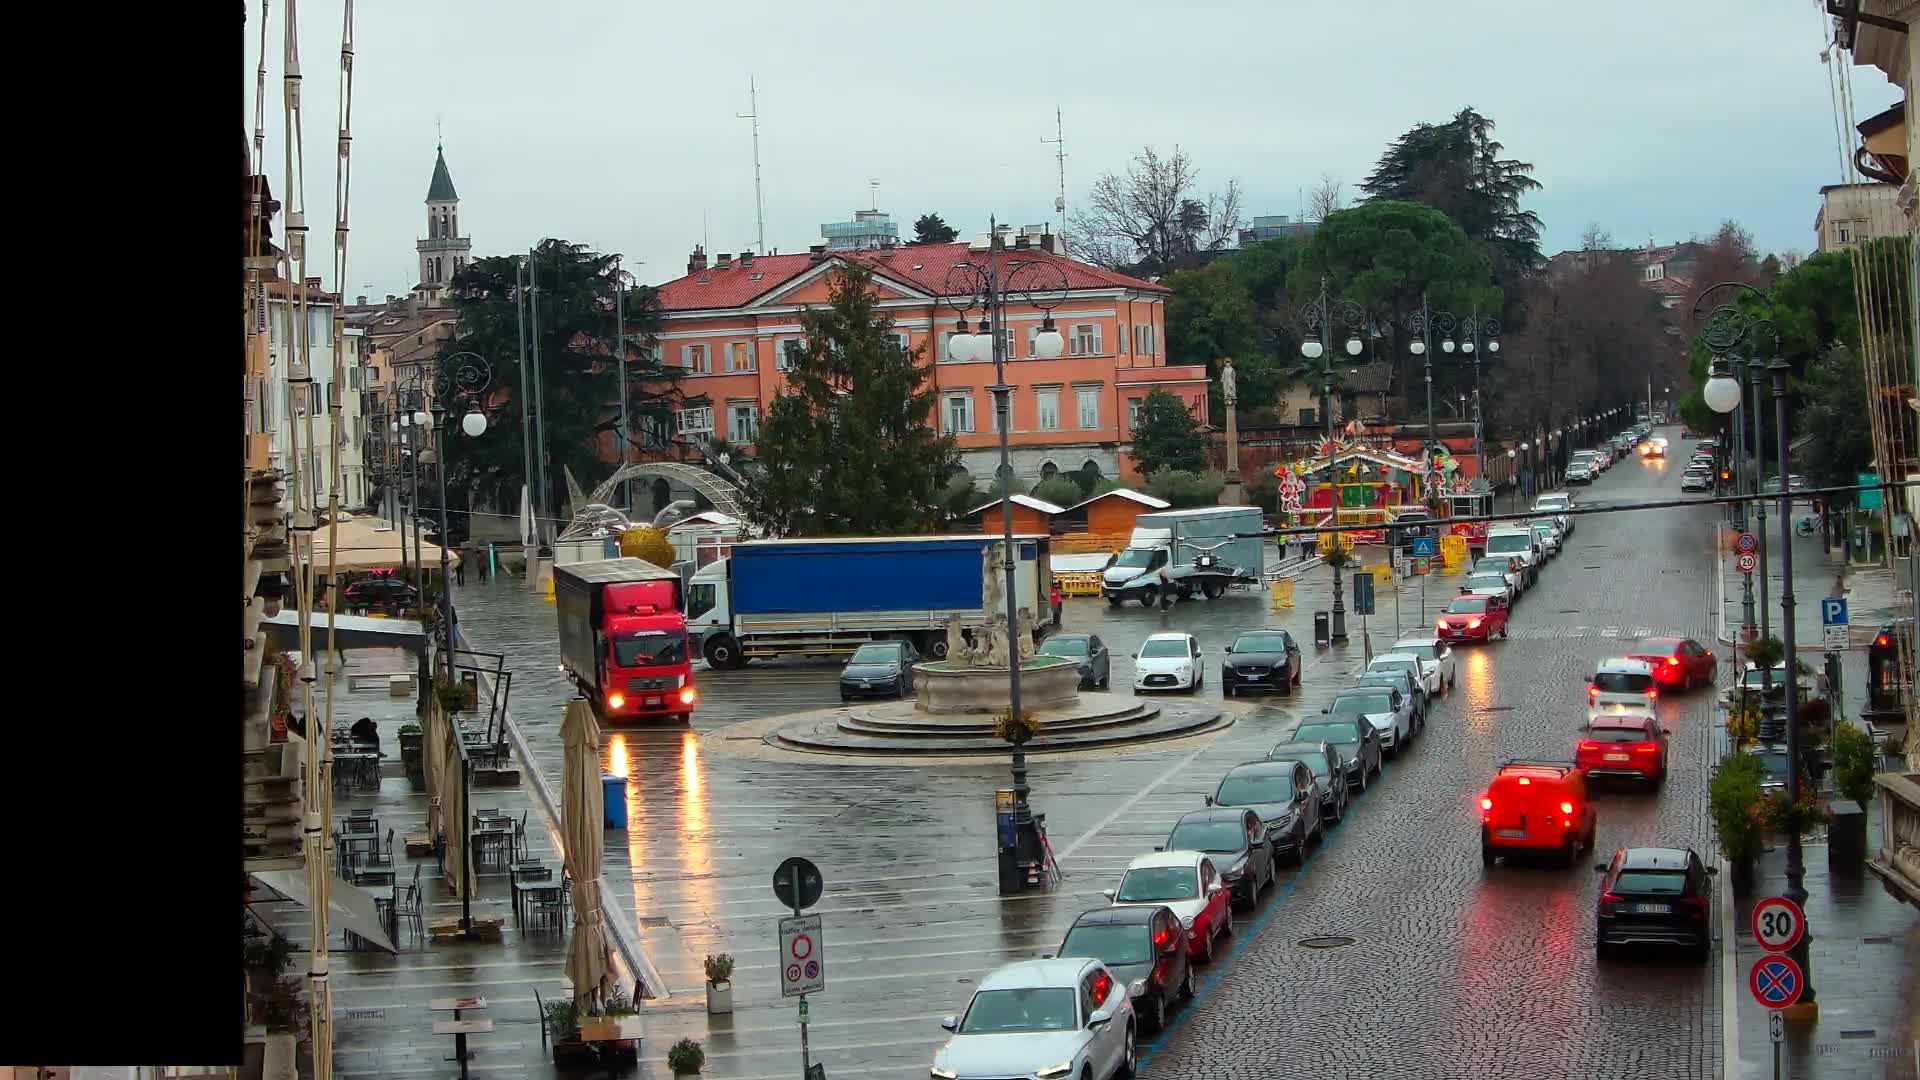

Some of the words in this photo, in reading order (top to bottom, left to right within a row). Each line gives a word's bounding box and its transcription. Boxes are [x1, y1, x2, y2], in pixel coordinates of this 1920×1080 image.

[1742, 557, 1752, 567] 20
[1826, 602, 1842, 623] P
[1762, 911, 1792, 937] 30
